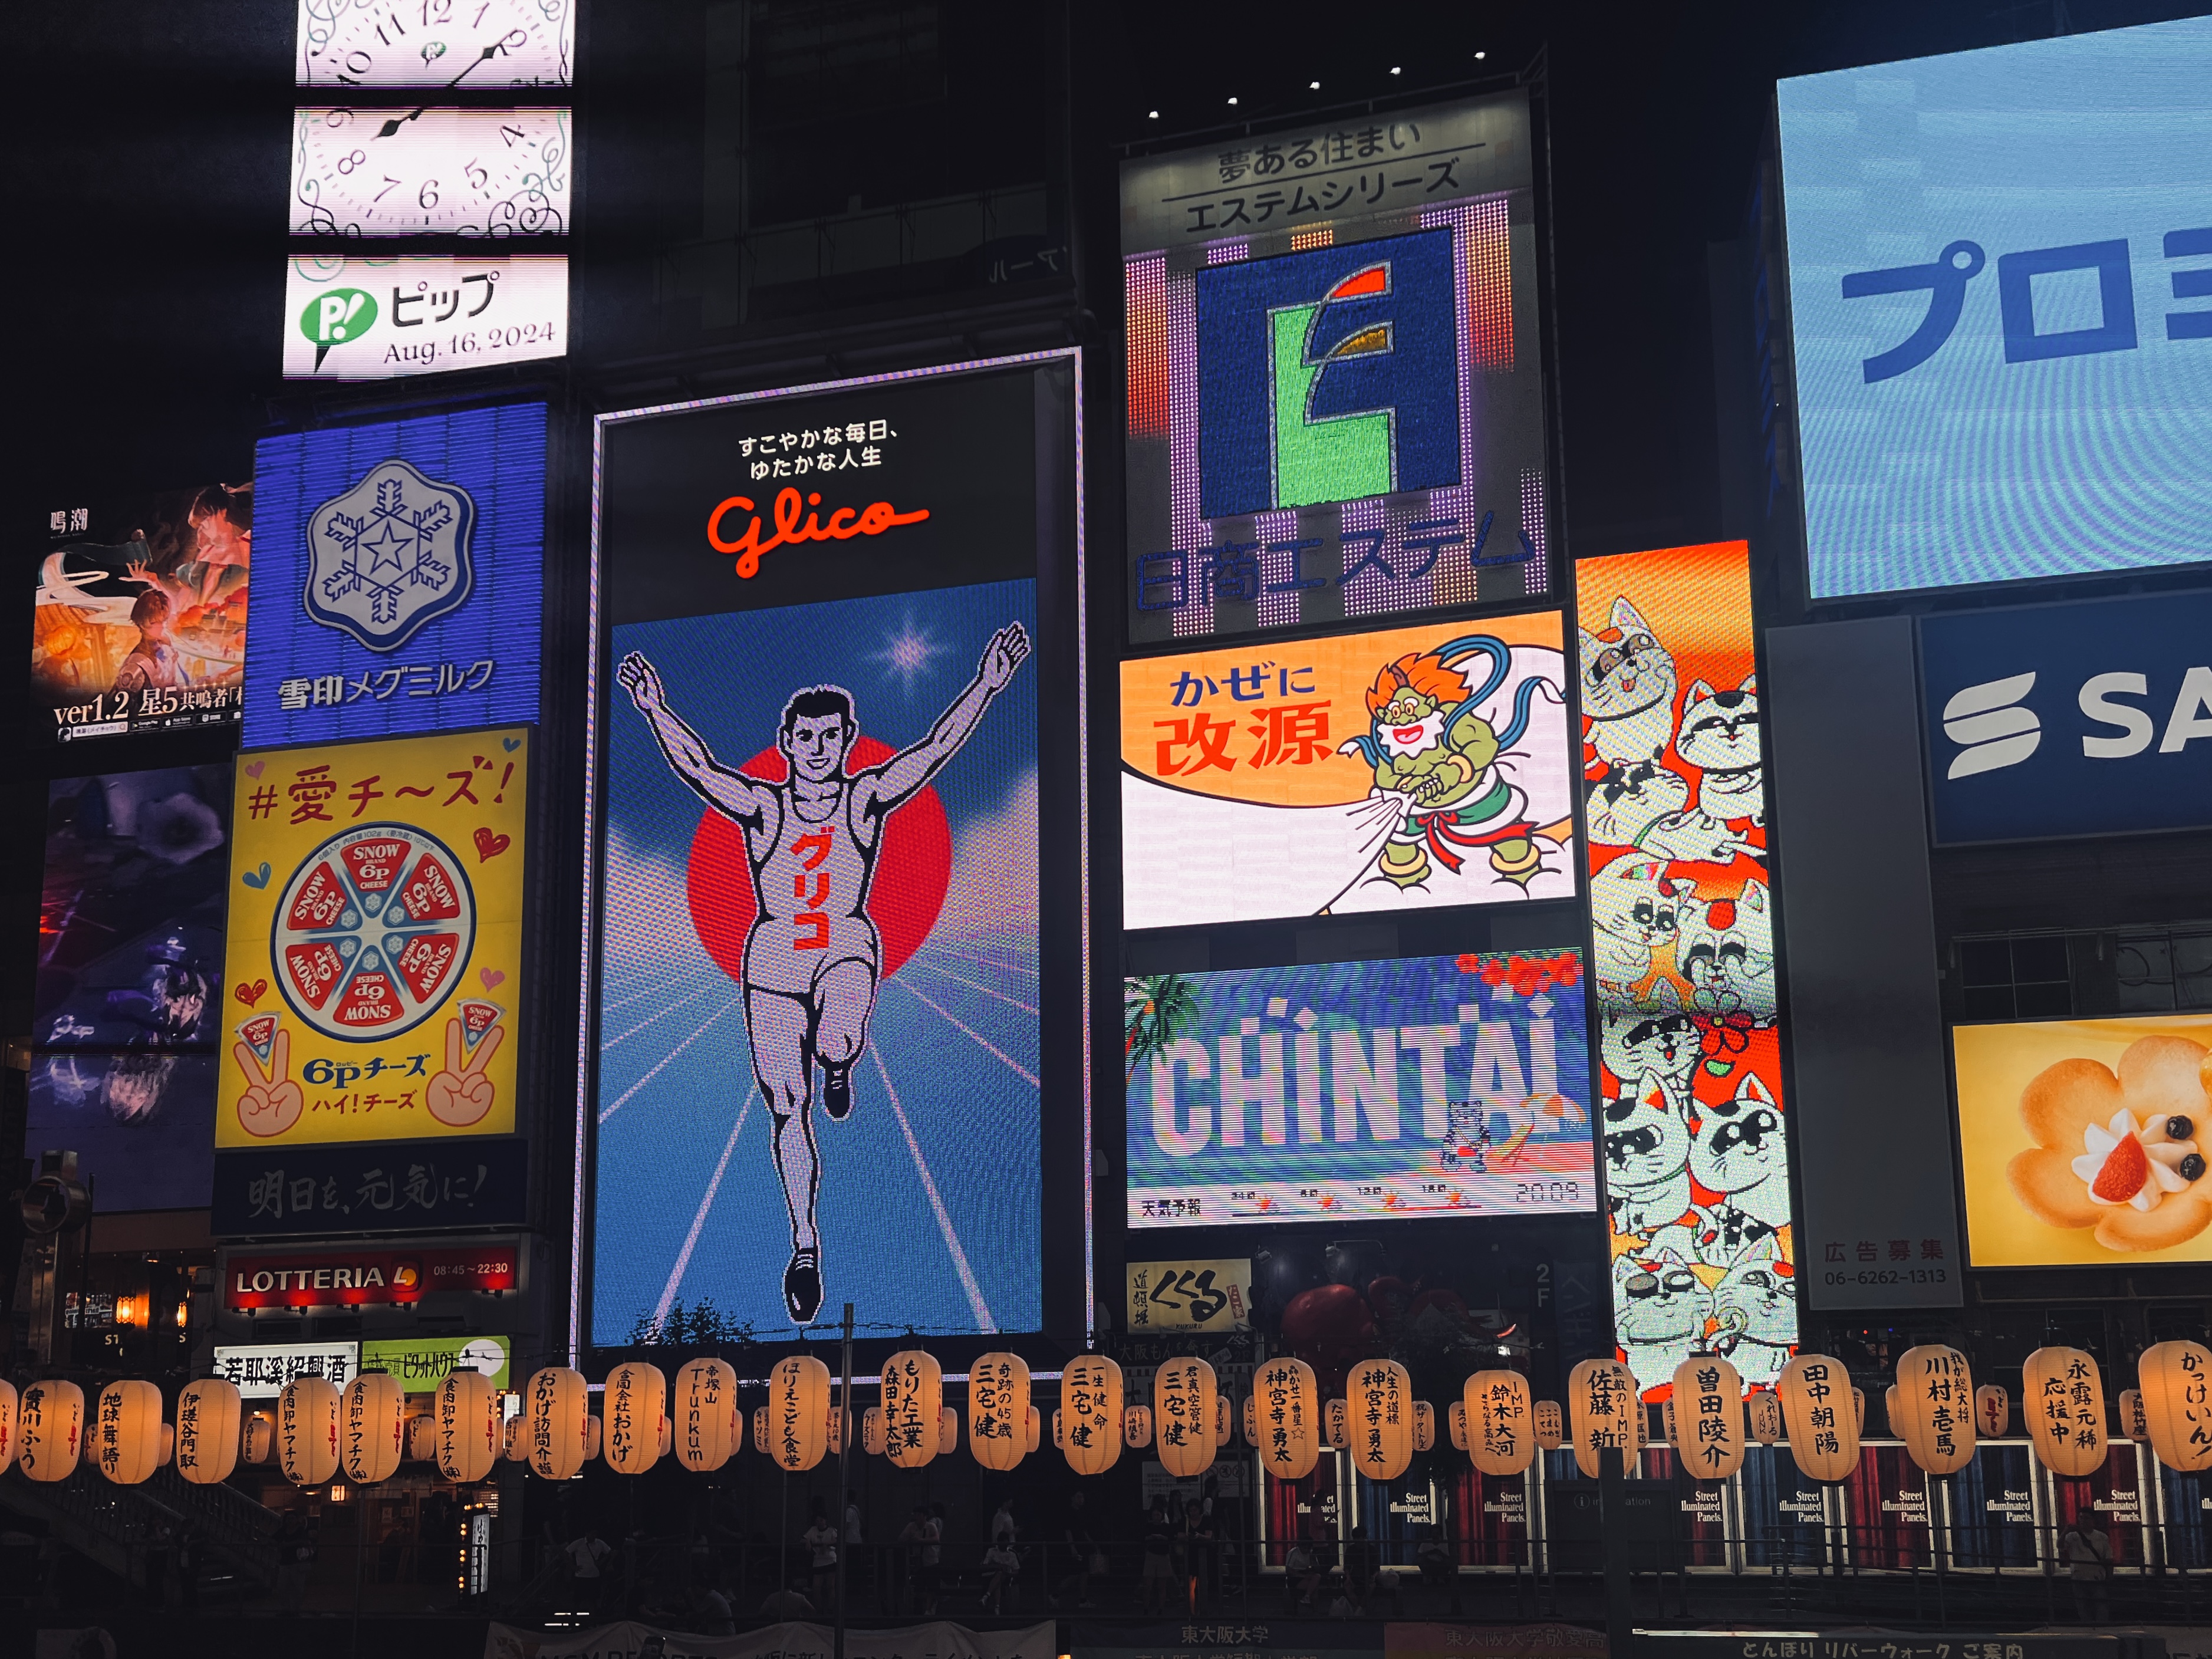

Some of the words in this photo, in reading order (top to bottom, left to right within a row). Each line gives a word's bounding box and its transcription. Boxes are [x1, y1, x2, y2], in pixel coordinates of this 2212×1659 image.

[1218, 123, 1421, 182] 夢ある住まい
[1185, 158, 1460, 232] エステムシリーズ
[391, 271, 501, 328] ピップ
[383, 343, 443, 365] Aug.
[488, 321, 557, 348] 2024
[738, 419, 898, 457] すこやかな毎日、
[750, 446, 883, 480] ゆたかな人生
[707, 486, 930, 580] Glico
[1136, 511, 1535, 611] 日商エステム
[278, 660, 494, 712] 雪印メグミルク
[1170, 660, 1315, 707] かぜに
[54, 690, 129, 725] ver1.2
[1154, 700, 1334, 776] 改源
[353, 844, 401, 861] SNOW
[294, 871, 327, 920] SNOW
[360, 880, 389, 890] CHEESE
[402, 891, 421, 919] CHEESE
[424, 865, 456, 909] SNOW
[790, 826, 835, 951] グリコ
[325, 897, 345, 926] CHEESE
[324, 944, 342, 972] CHEESE
[399, 939, 419, 967] CHEESE
[420, 943, 452, 994] SNOW
[290, 954, 321, 999] SNOW
[356, 975, 384, 984] CHEESE
[344, 1005, 391, 1021] SNOW
[1142, 1197, 1201, 1218] 天気予報
[1825, 1239, 1944, 1263] 広告募集
[237, 1267, 385, 1293] LOTTERIA
[1133, 1269, 1149, 1326] 道頓堀
[1149, 1270, 1227, 1322] くくる
[1825, 1269, 1946, 1286] 06-6262-1313
[705, 1365, 720, 1404] 帝塚山
[900, 1359, 924, 1449] もりた工業
[996, 1362, 1013, 1439] 奇跡の45歳
[1092, 1366, 1108, 1431] 一生健命
[1386, 1366, 1399, 1425] 人生の道標
[1925, 1357, 1956, 1456] 川村壱馬
[1950, 1352, 1969, 1424] 我が総大将
[2067, 1359, 2097, 1451] 永露元稀
[533, 1372, 557, 1474] おかげ訪問介護
[612, 1369, 636, 1463] 合同会社おかげ
[687, 1368, 705, 1462] Trunkum
[782, 1362, 801, 1467] ほりえこども食堂
[885, 1365, 903, 1458] 森田幸太郎
[1070, 1367, 1094, 1449] 三宅健
[1163, 1371, 1189, 1447] 三宅健
[1265, 1368, 1292, 1462] 神宮寺勇太
[1331, 1404, 1344, 1444] たかてる
[1362, 1368, 1387, 1462] 神宮寺勇太
[1490, 1384, 1517, 1457] 鈴木大河
[1696, 1366, 1730, 1468] 曽田陵介
[1802, 1365, 1839, 1455] 田中朝陽
[2043, 1377, 2071, 1444] 応援中
[1405, 1492, 1427, 1503] Street
[1500, 1492, 1522, 1502] Street
[1695, 1490, 1718, 1501] Street
[1697, 1511, 1723, 1522] Panels.
[1796, 1490, 1819, 1502] Street
[1899, 1490, 1923, 1501] Street
[2004, 1489, 2028, 1500] Street
[2006, 1511, 2033, 1522] Panels.
[2111, 1489, 2136, 1500] Street
[2113, 1511, 2141, 1522] Panels.
[1407, 1512, 1431, 1523] Panels.
[1501, 1512, 1526, 1523] Panels.
[1798, 1512, 1824, 1523] Panels.
[1901, 1512, 1929, 1522] Panels.
[1181, 1624, 1269, 1644] 東大阪大学
[1742, 1641, 1815, 1658] とんぼり
[1825, 1641, 1951, 1658] リバーウォーク
[1962, 1642, 2024, 1659] ご案内
